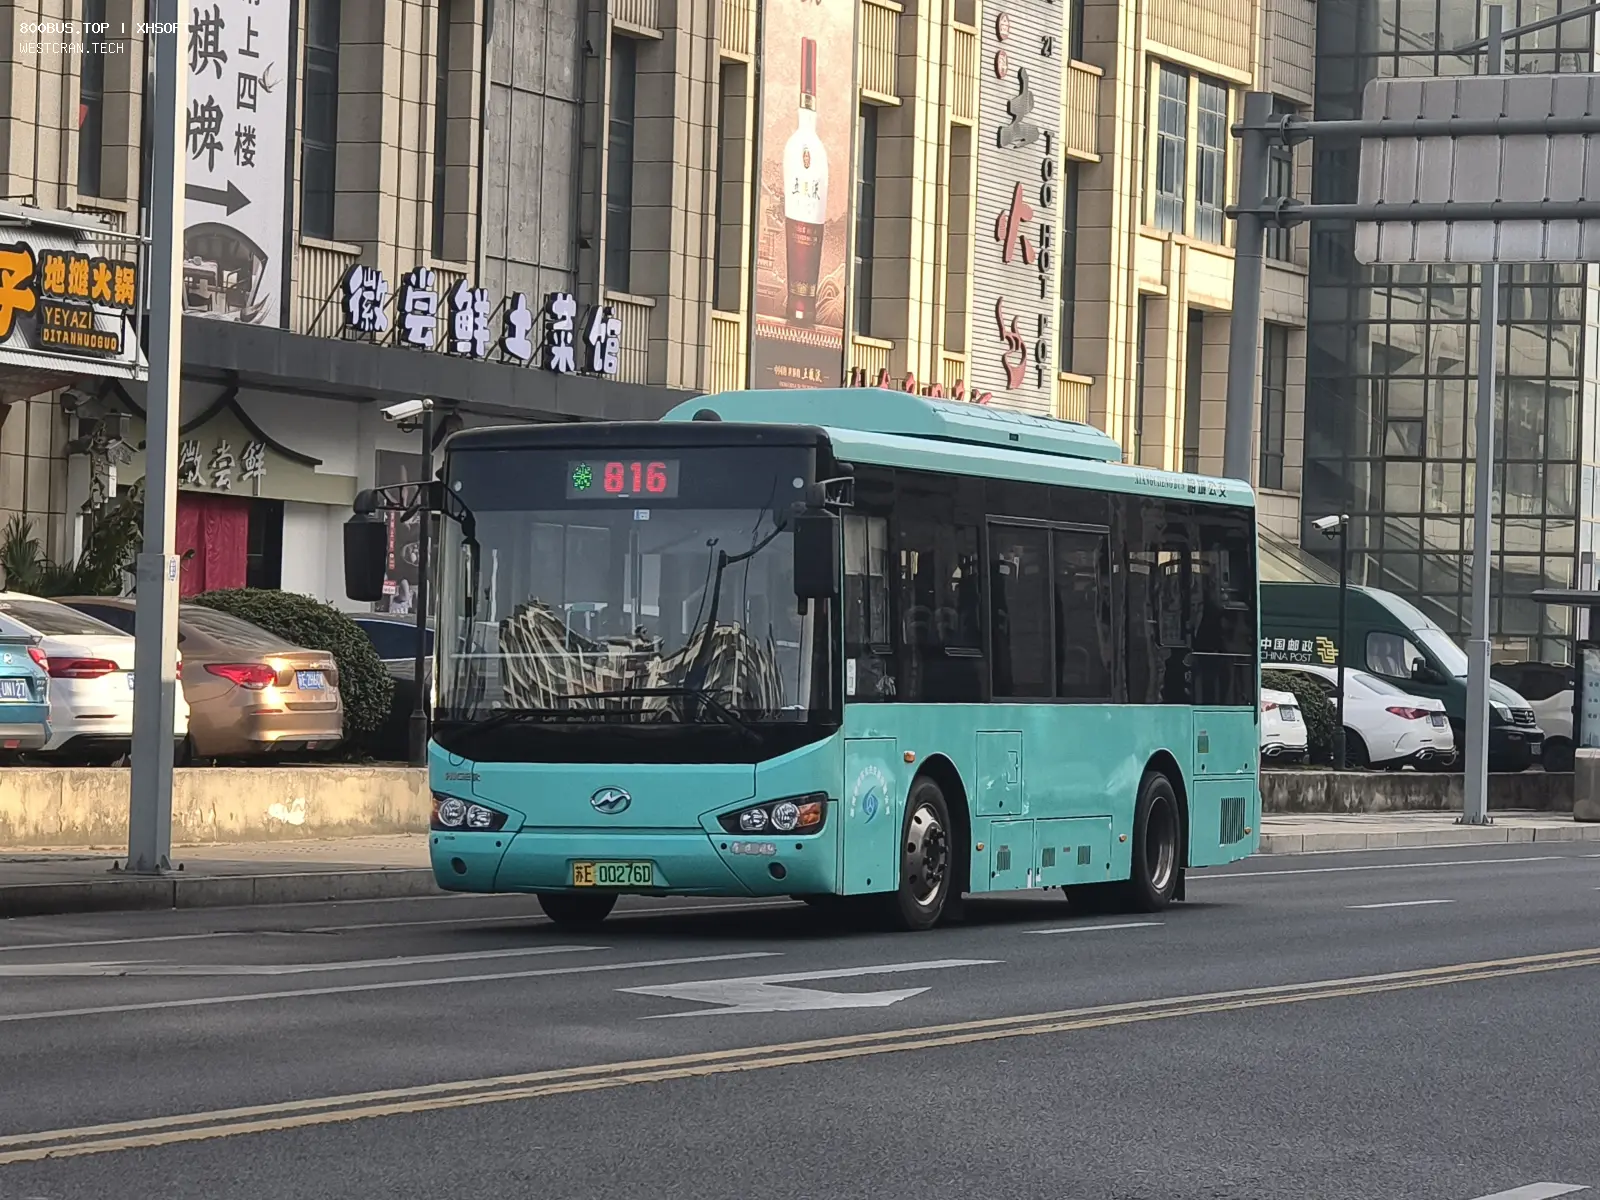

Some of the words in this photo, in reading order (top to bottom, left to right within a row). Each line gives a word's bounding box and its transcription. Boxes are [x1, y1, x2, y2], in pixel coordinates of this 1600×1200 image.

[45, 306, 93, 330] YEYAZI
[345, 263, 622, 375] 徽尝鲜土菜馆
[43, 328, 117, 350] DITANHUOGUO
[604, 462, 667, 492] 816
[1260, 637, 1314, 652] 中国邮政
[1260, 651, 1288, 661] CHINA
[1290, 653, 1312, 662] POST
